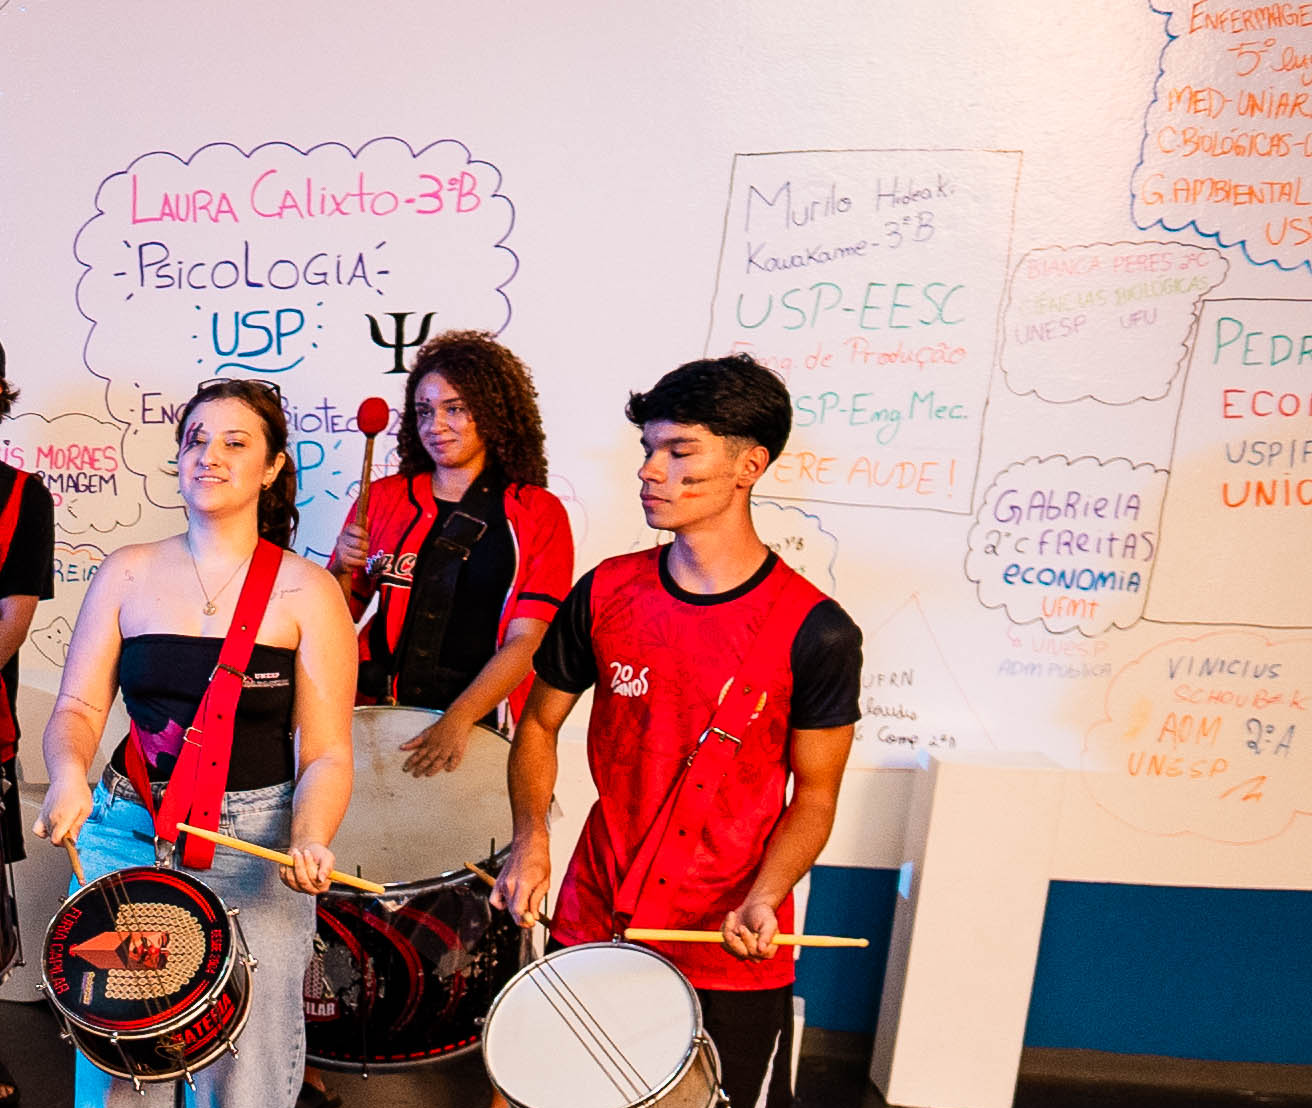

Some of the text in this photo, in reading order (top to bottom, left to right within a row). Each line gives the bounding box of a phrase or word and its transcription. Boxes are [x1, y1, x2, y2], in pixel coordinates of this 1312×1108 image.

[746, 181, 852, 232] Murilo
[1265, 217, 1312, 246] US
[211, 308, 305, 357] USP
[1014, 314, 1088, 345] UNESP
[1213, 316, 1312, 366] PEDR
[806, 347, 833, 370] de
[1223, 388, 1312, 419] ECO
[36, 444, 119, 472] MORAES
[773, 451, 838, 485] ERE
[37, 470, 118, 496] MAGEM
[610, 661, 633, 690] 20
[613, 667, 650, 697] ANOS
[1168, 655, 1283, 680] VINICIUS
[1127, 751, 1230, 779] UNESP
[305, 1001, 336, 1016] ILAR
